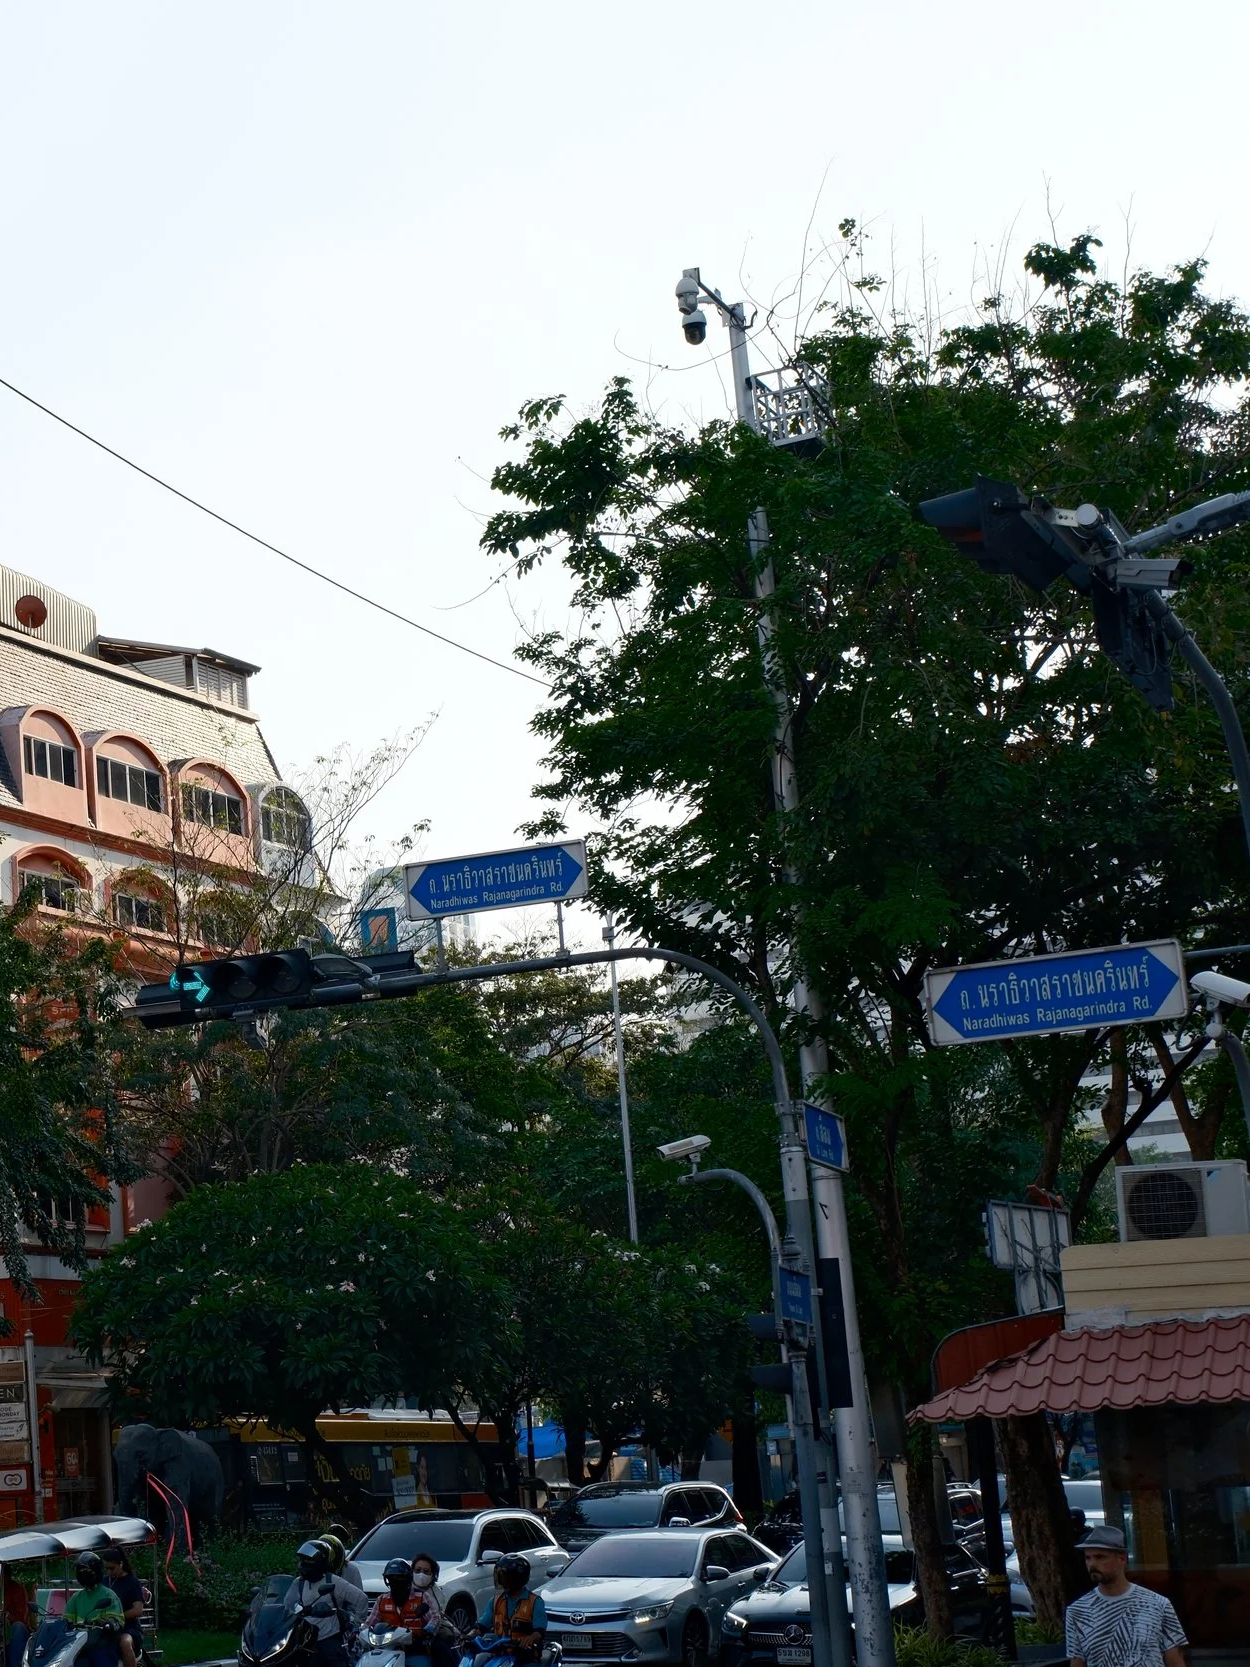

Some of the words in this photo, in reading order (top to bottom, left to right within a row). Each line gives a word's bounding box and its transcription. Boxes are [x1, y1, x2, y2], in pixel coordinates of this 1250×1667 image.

[442, 852, 563, 892] นราธิวาสราชนครินทร์
[431, 895, 478, 909] Naradhiwas
[483, 885, 545, 903] Rajanagarindra
[550, 882, 563, 892] Rd.
[961, 988, 976, 1009] ถ.
[978, 956, 1150, 1007] นราธิวาสราชนครินทร์
[963, 1012, 1030, 1031] Naradhiwas
[1037, 1001, 1126, 1023] Rajanagarindra
[1133, 995, 1152, 1010] Rd.
[794, 1649, 810, 1657] 1298
